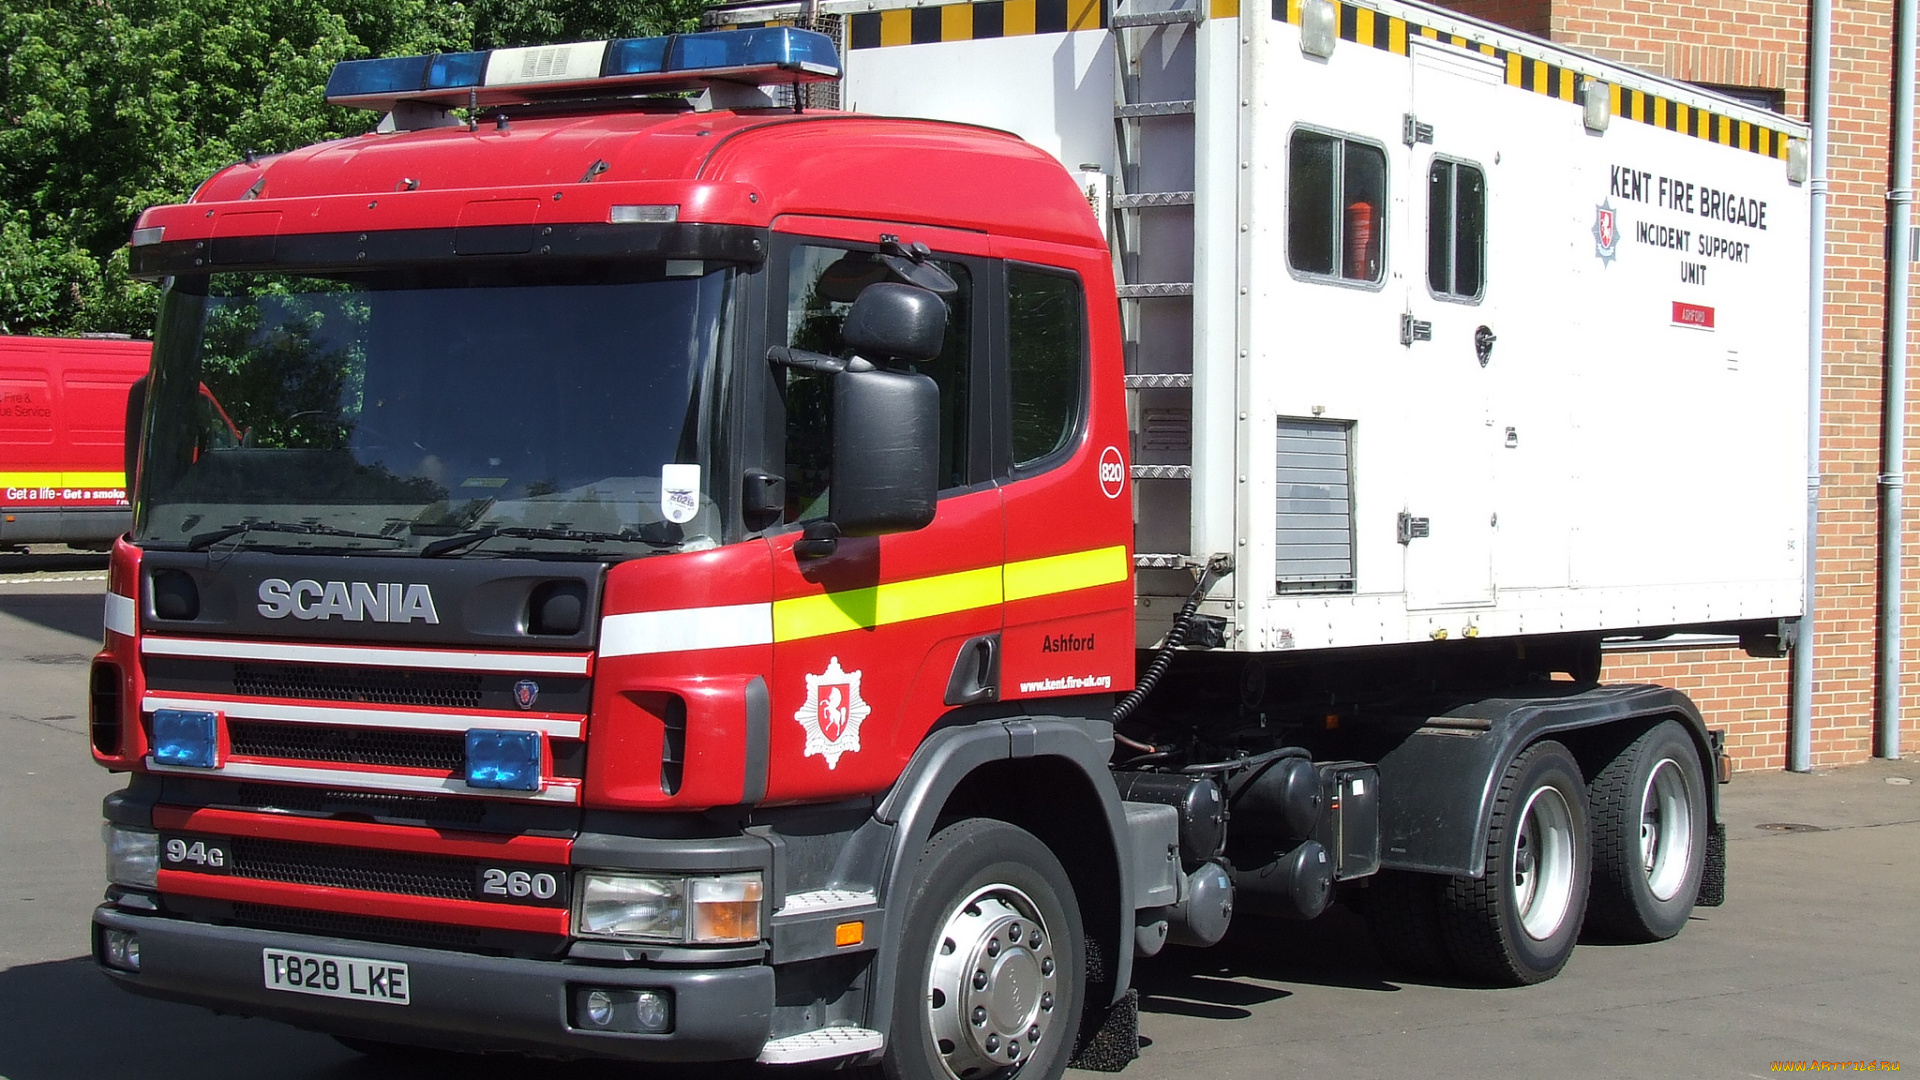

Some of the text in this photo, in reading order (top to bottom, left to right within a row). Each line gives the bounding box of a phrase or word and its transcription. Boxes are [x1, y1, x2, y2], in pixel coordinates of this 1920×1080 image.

[1611, 164, 1767, 230] KENT FIRE BRIGADE
[1636, 220, 1749, 264] INCIDENT SUPPORT
[1681, 261, 1706, 286] UNIT
[1681, 308, 1706, 323] ASHFORD
[15, 405, 51, 418] Service
[1102, 463, 1122, 482] 820
[7, 488, 27, 500] Get
[29, 490, 37, 499] a
[63, 489, 82, 499] Get
[83, 490, 91, 499] a
[92, 489, 126, 499] smoke
[257, 578, 440, 625] SCANIA
[1042, 633, 1095, 653] Ashford
[1020, 675, 1111, 692] www.kent.fire-uk.org
[482, 868, 557, 899] 260
[267, 953, 406, 999] T828 LKE
